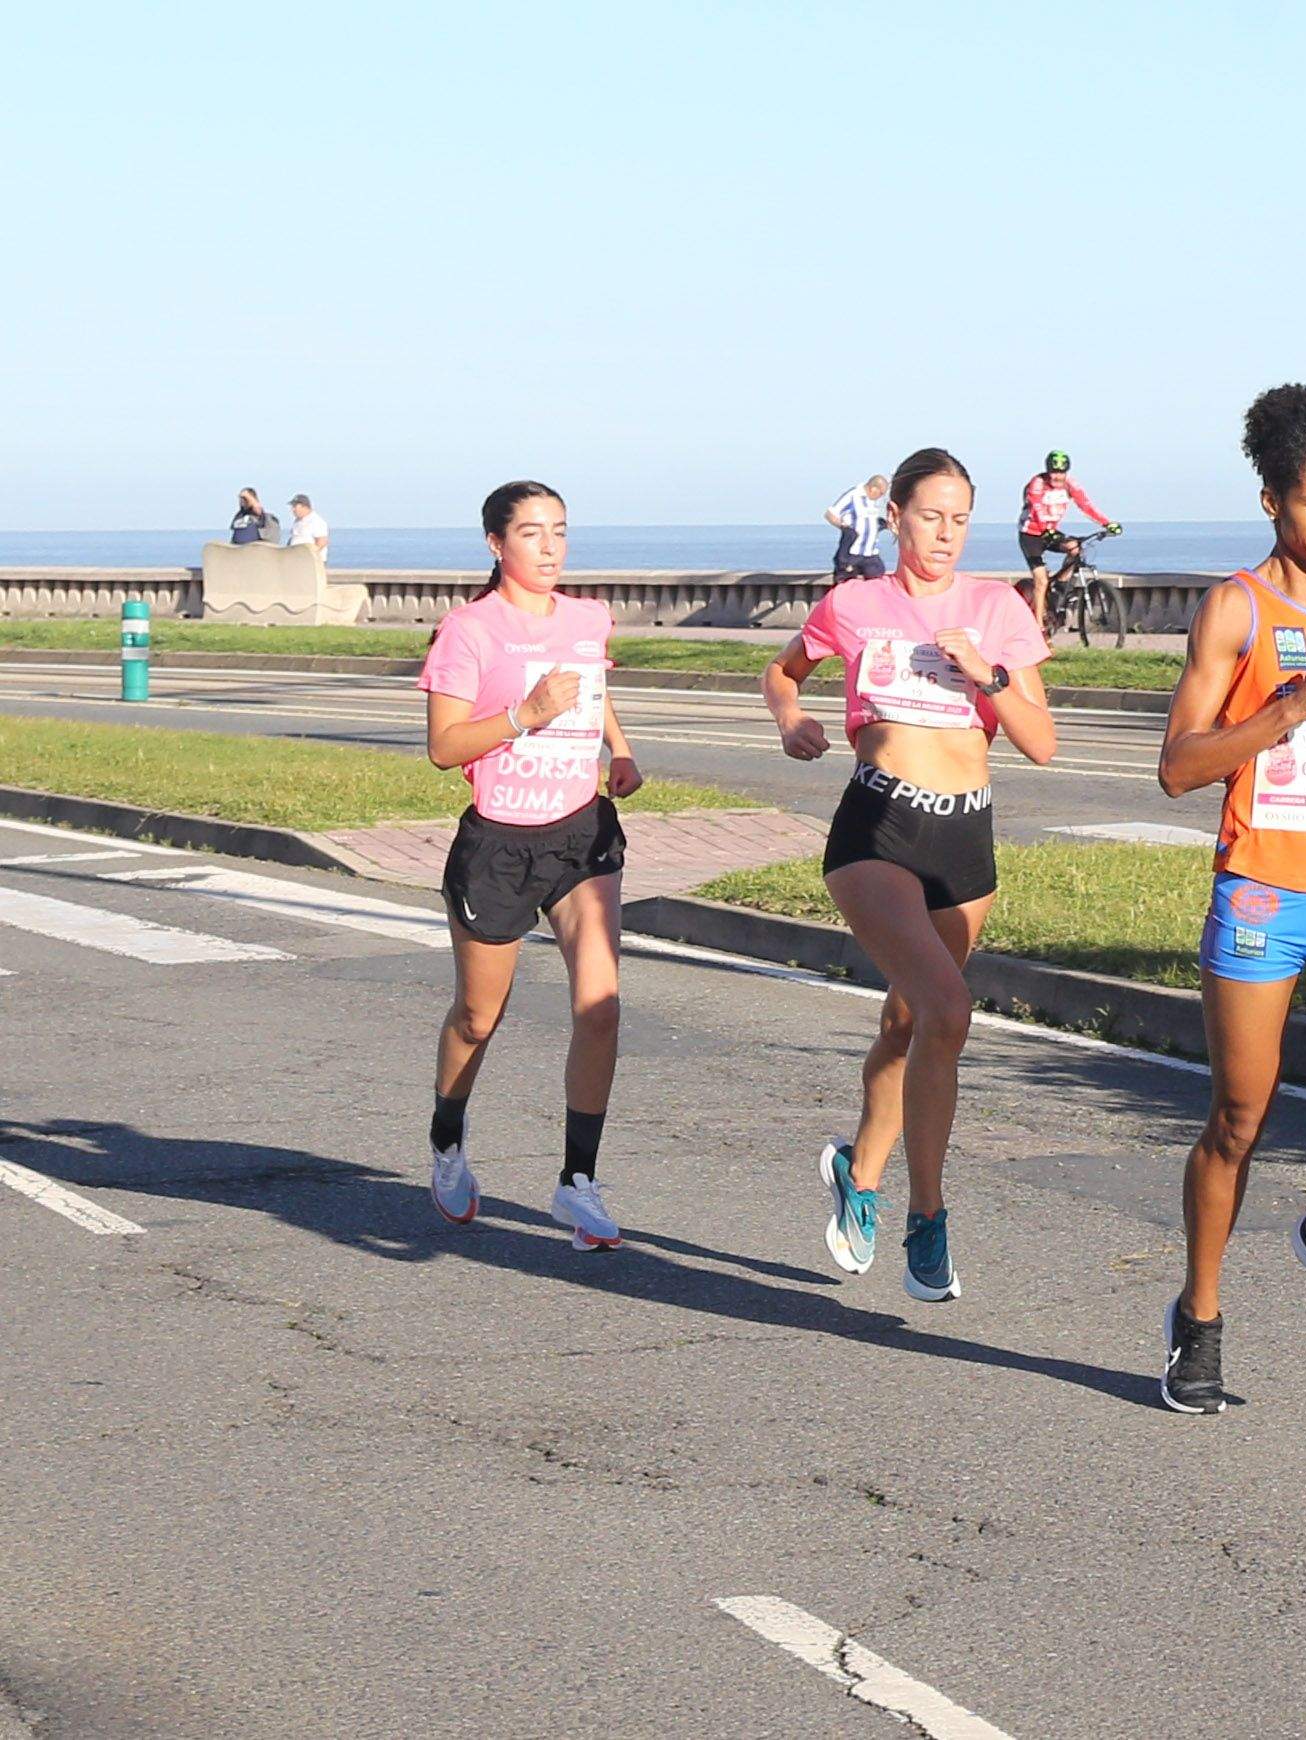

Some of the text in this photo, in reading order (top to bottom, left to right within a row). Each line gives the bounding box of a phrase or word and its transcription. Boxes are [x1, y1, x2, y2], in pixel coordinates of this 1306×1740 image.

[497, 752, 590, 780] DORSAL
[490, 784, 564, 811] SUMA
[891, 780, 956, 816] PRO
